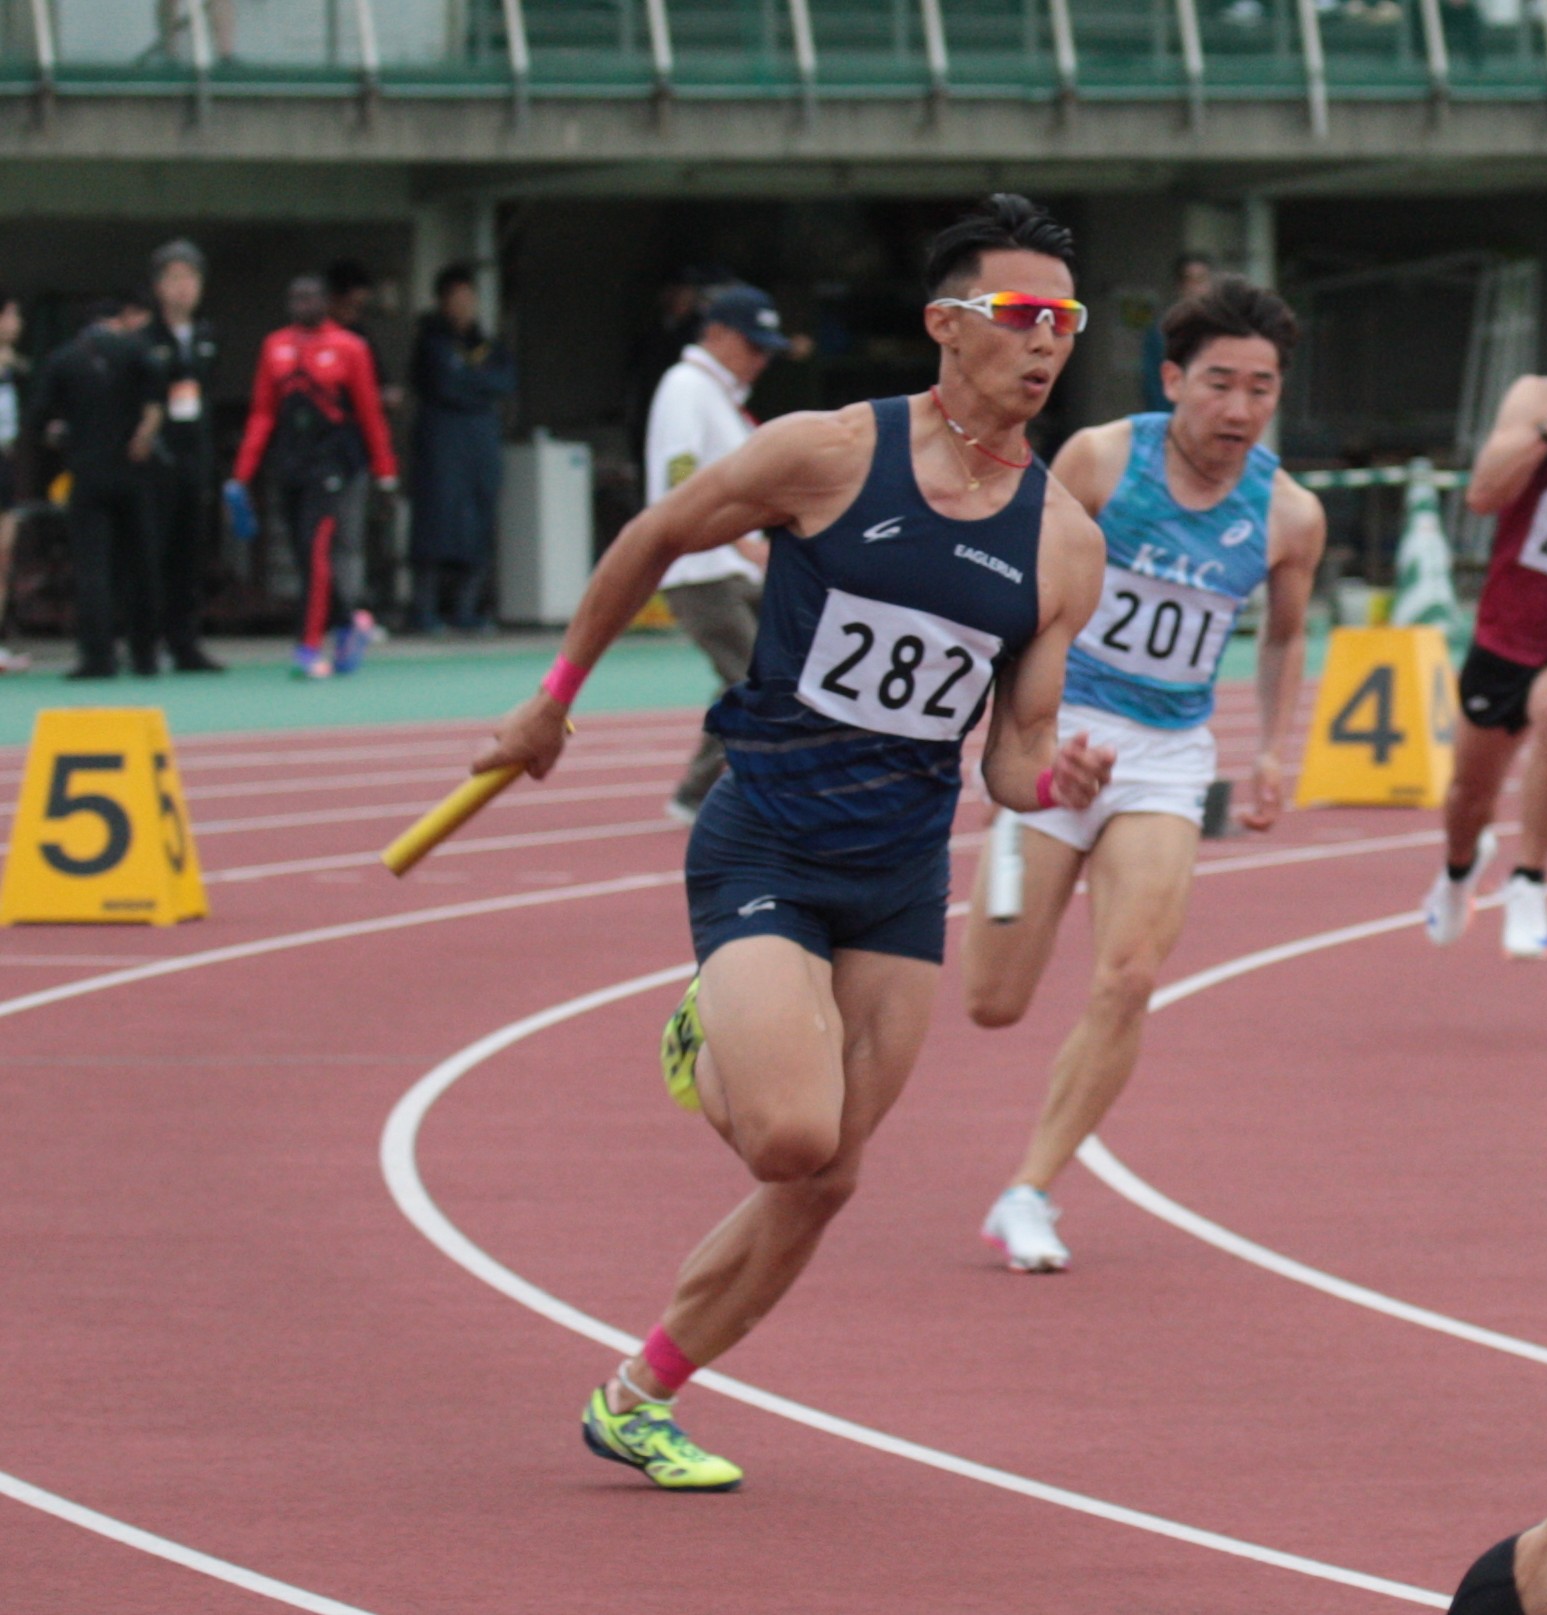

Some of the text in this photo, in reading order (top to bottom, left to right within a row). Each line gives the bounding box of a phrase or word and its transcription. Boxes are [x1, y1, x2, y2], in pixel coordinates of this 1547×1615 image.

[953, 543, 1024, 585] EAGLERUN
[1131, 543, 1226, 590] KAC
[820, 621, 974, 719] 282
[1102, 591, 1213, 668] 201
[1330, 666, 1405, 766] 4
[39, 755, 132, 877] 5
